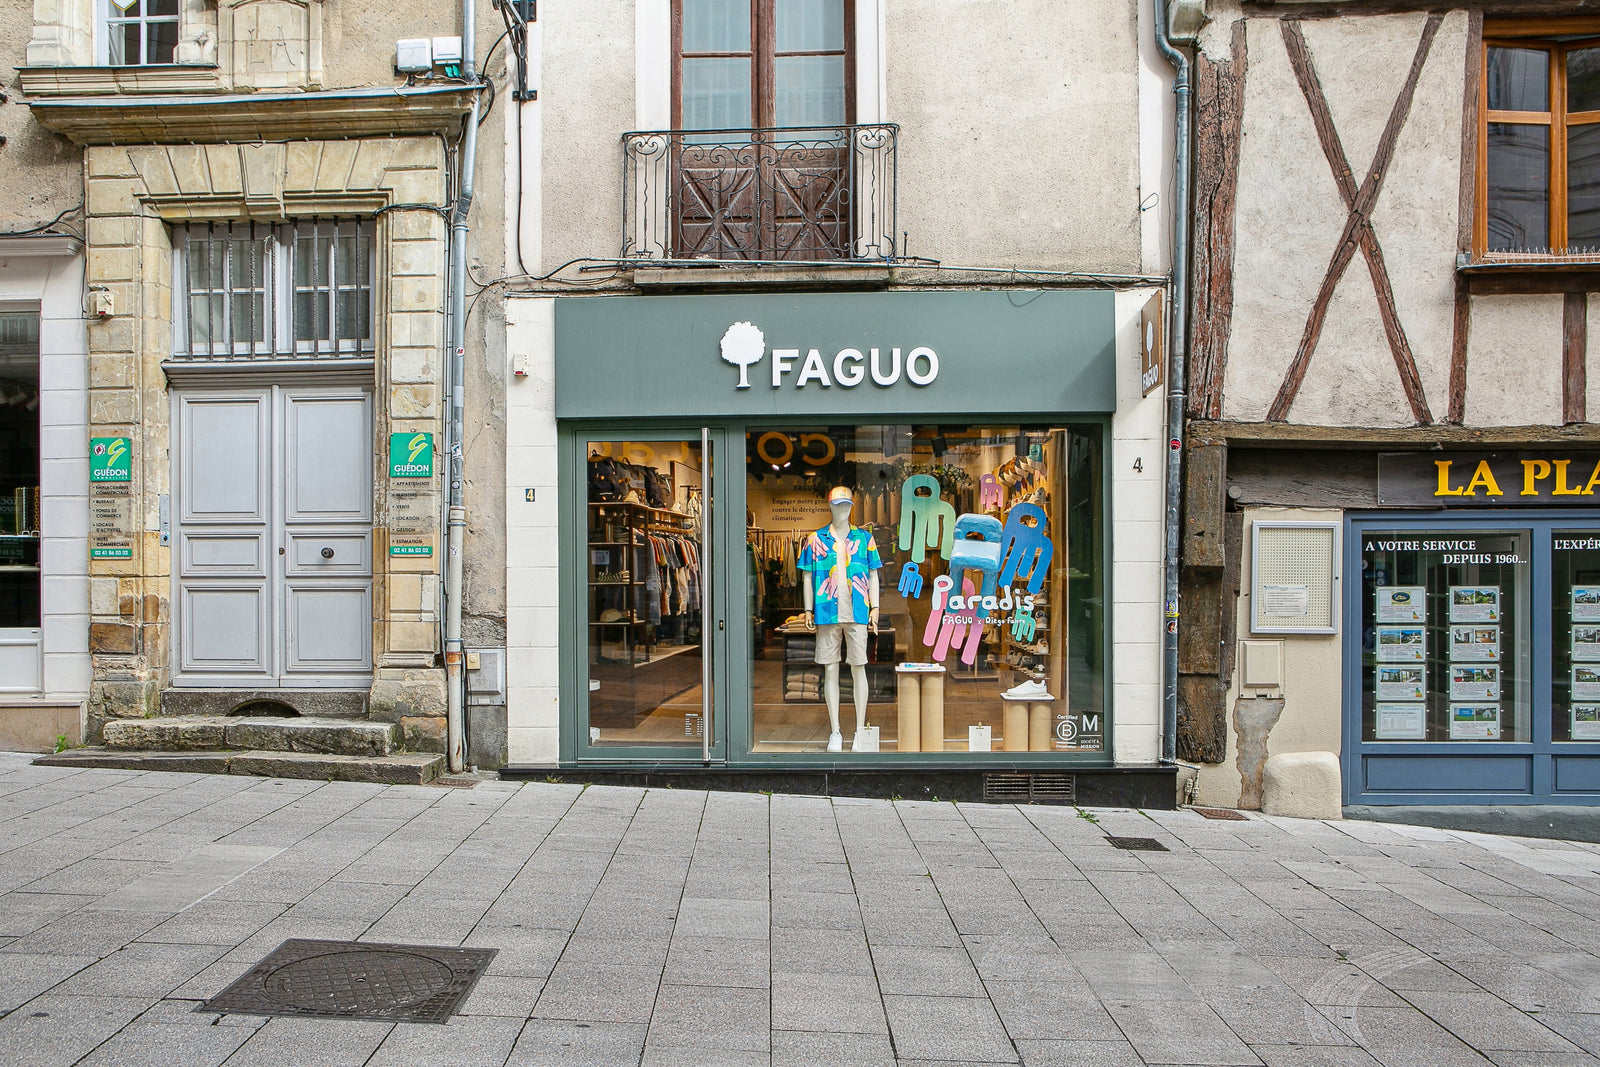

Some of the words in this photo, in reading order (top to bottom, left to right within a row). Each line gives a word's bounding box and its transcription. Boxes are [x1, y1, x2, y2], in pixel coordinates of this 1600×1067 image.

[772, 346, 940, 388] FAGUO
[1142, 363, 1159, 392] FAGUO
[394, 463, 430, 472] GUÉDON
[1133, 456, 1143, 473] 4
[94, 467, 128, 477] GUÉDON
[1434, 460, 1504, 496] LA
[526, 488, 535, 502] 4
[1365, 541, 1375, 551] A
[1377, 541, 1420, 551] VOTRE
[1422, 540, 1476, 551] SERVICE
[1443, 554, 1492, 565] DEPUIS
[1495, 554, 1527, 565] 1960...
[932, 574, 1035, 611] Paradis
[943, 615, 973, 625] FAGUO
[985, 616, 1006, 627] Diego
[1082, 714, 1098, 731] M
[1062, 724, 1072, 737] B
